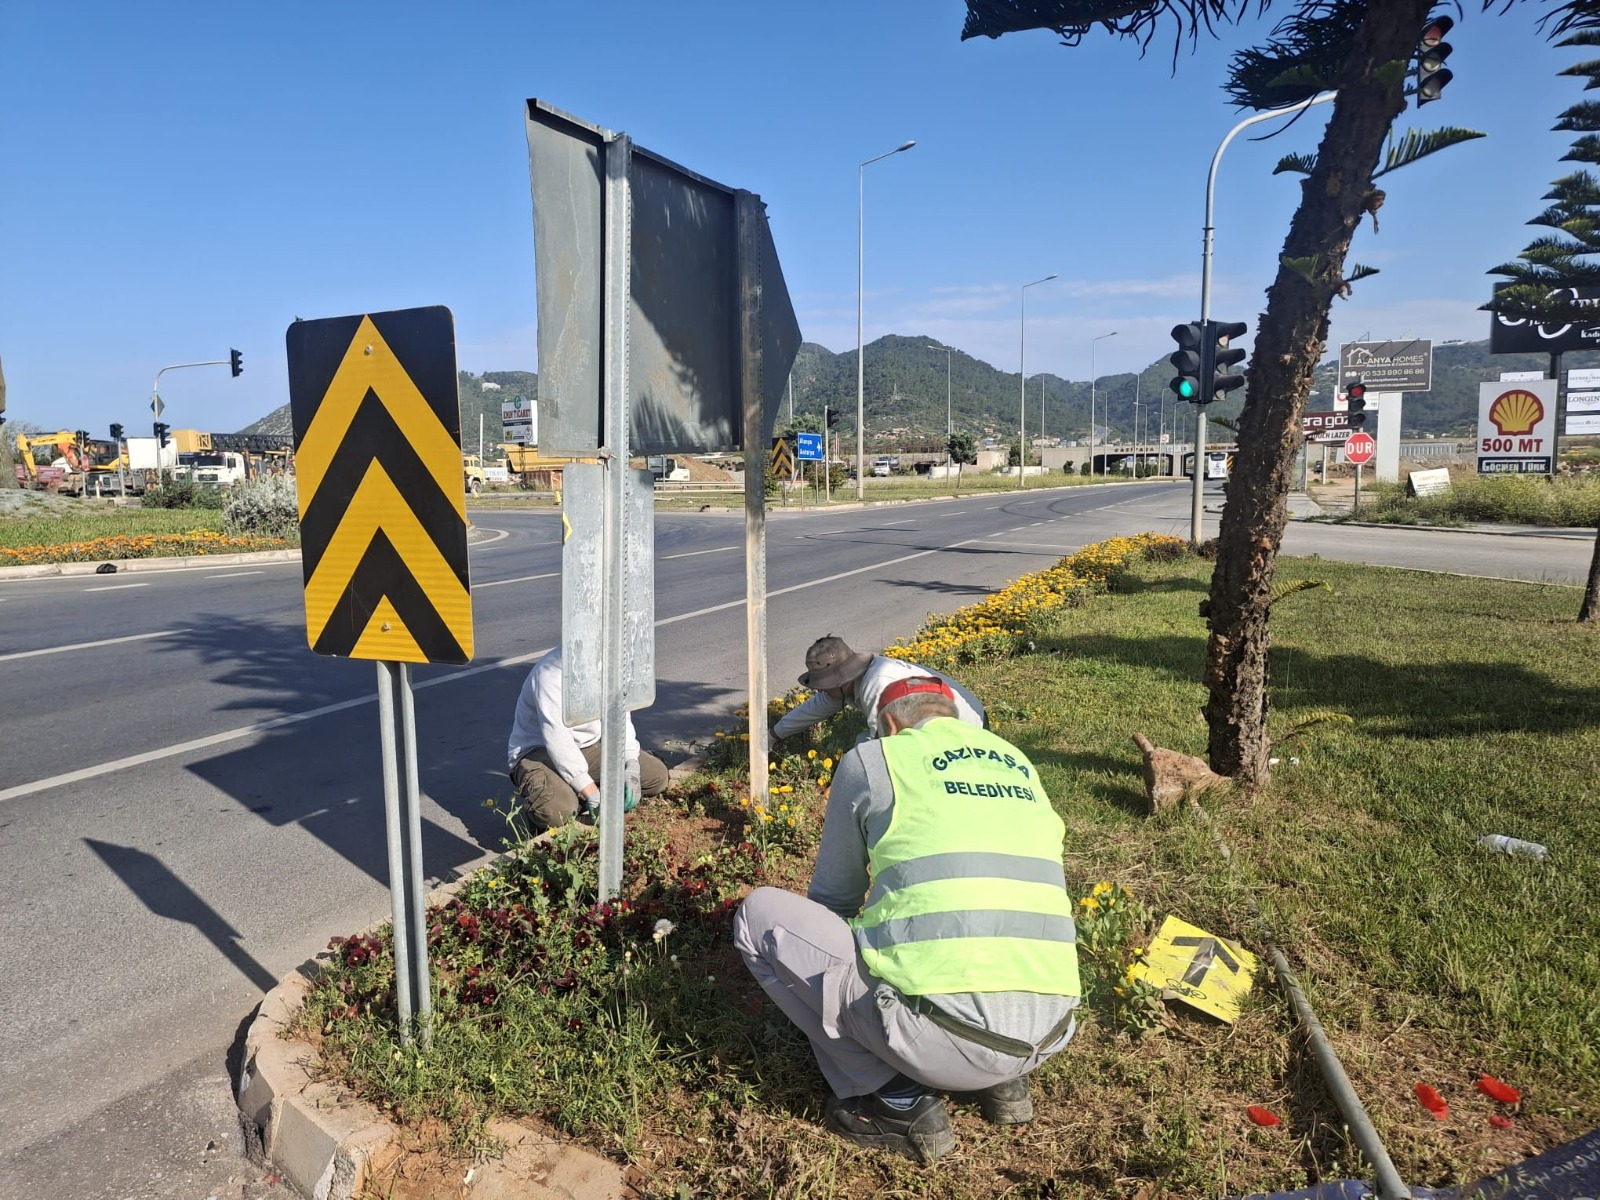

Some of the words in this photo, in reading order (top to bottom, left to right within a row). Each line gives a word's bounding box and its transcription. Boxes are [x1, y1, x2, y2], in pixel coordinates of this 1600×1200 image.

[1356, 356, 1391, 365] ALANYA
[1393, 355, 1424, 363] HOMES
[1347, 442, 1372, 454] DUR
[1482, 438, 1513, 452] 500
[1518, 438, 1543, 452] MT
[932, 745, 1030, 779] GAZİPAŞA
[944, 781, 1036, 803] BELEDİYESİ
